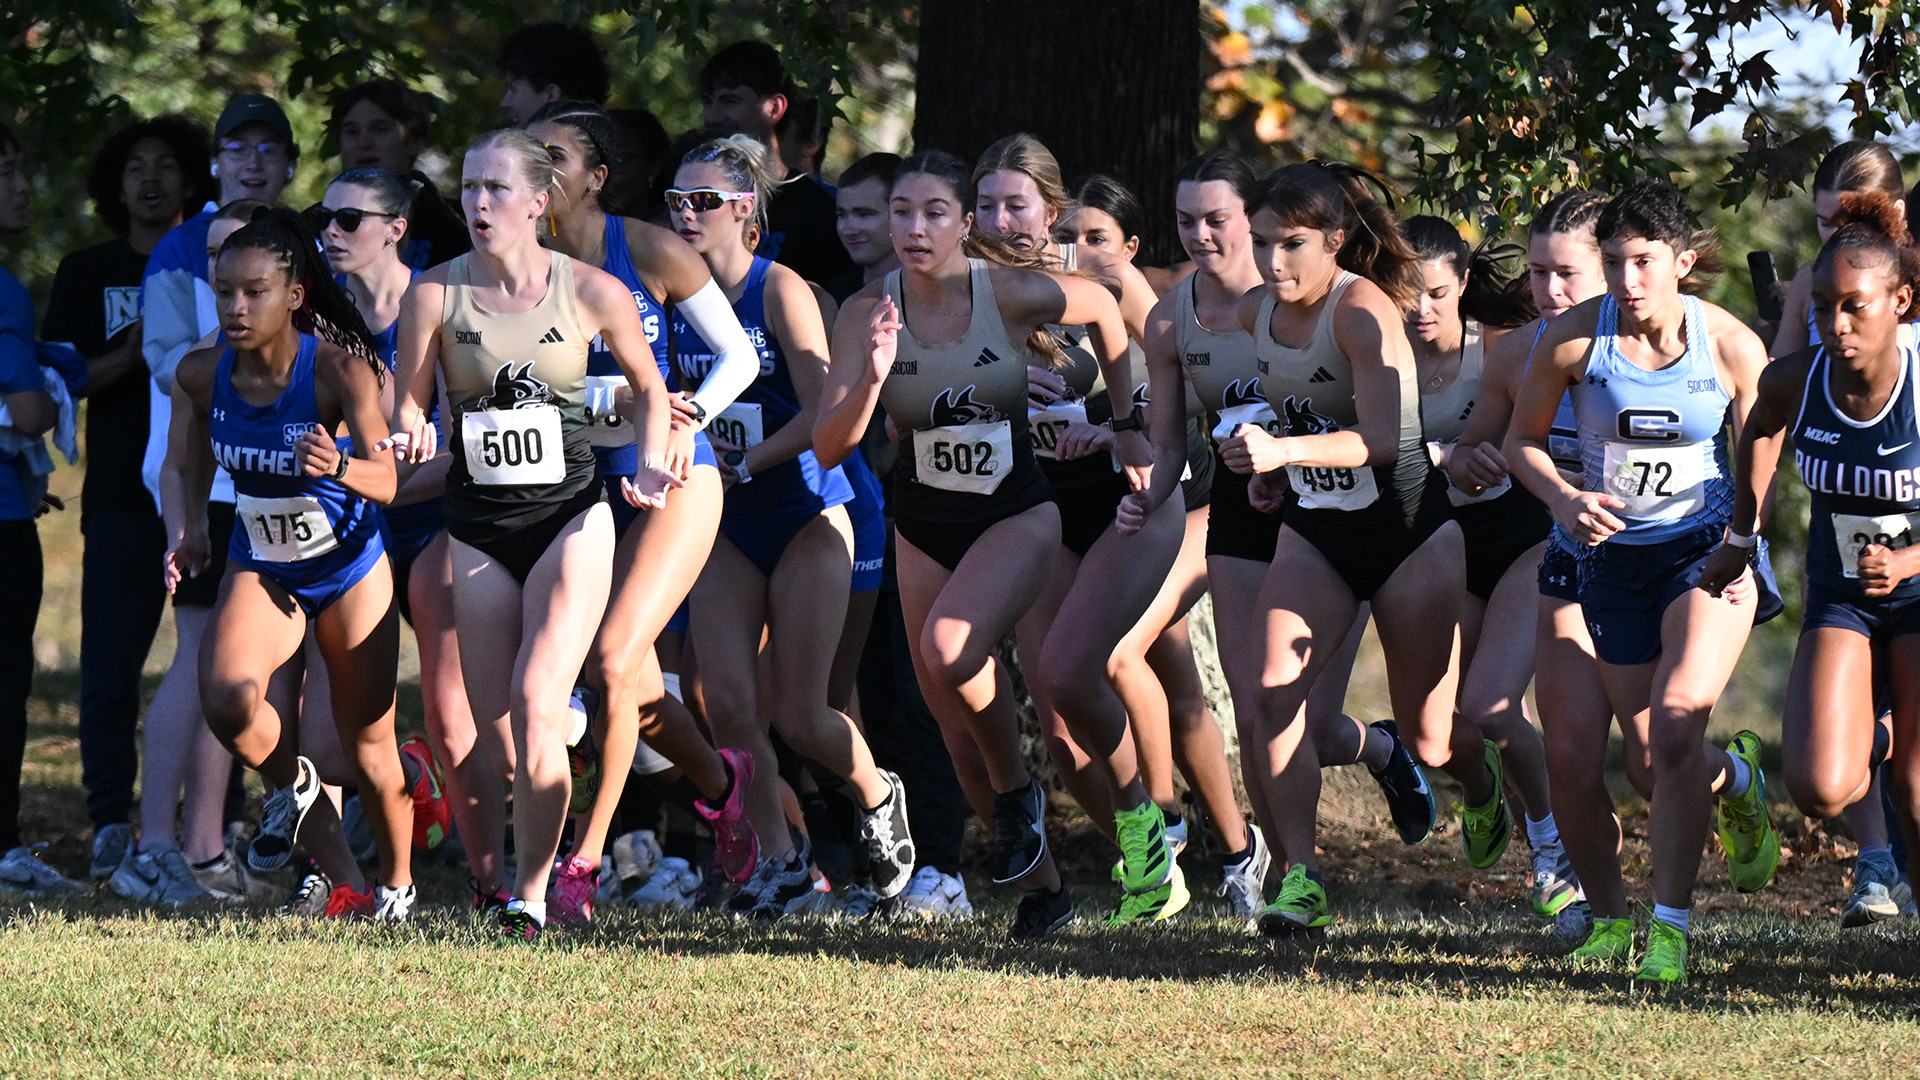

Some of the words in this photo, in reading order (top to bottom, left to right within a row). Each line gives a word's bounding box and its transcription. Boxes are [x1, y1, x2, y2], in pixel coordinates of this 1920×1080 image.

[456, 331, 482, 345] SOCON
[890, 361, 917, 375] SOCON
[1186, 352, 1210, 366] SOCON
[1687, 378, 1716, 394] SOCON
[709, 417, 746, 449] 80
[1617, 407, 1682, 442] C
[1804, 426, 1841, 445] MEAC
[483, 428, 543, 467] 500
[933, 441, 994, 475] 502
[1302, 466, 1355, 492] 499
[1633, 461, 1673, 497] 72
[256, 511, 313, 545] 175
